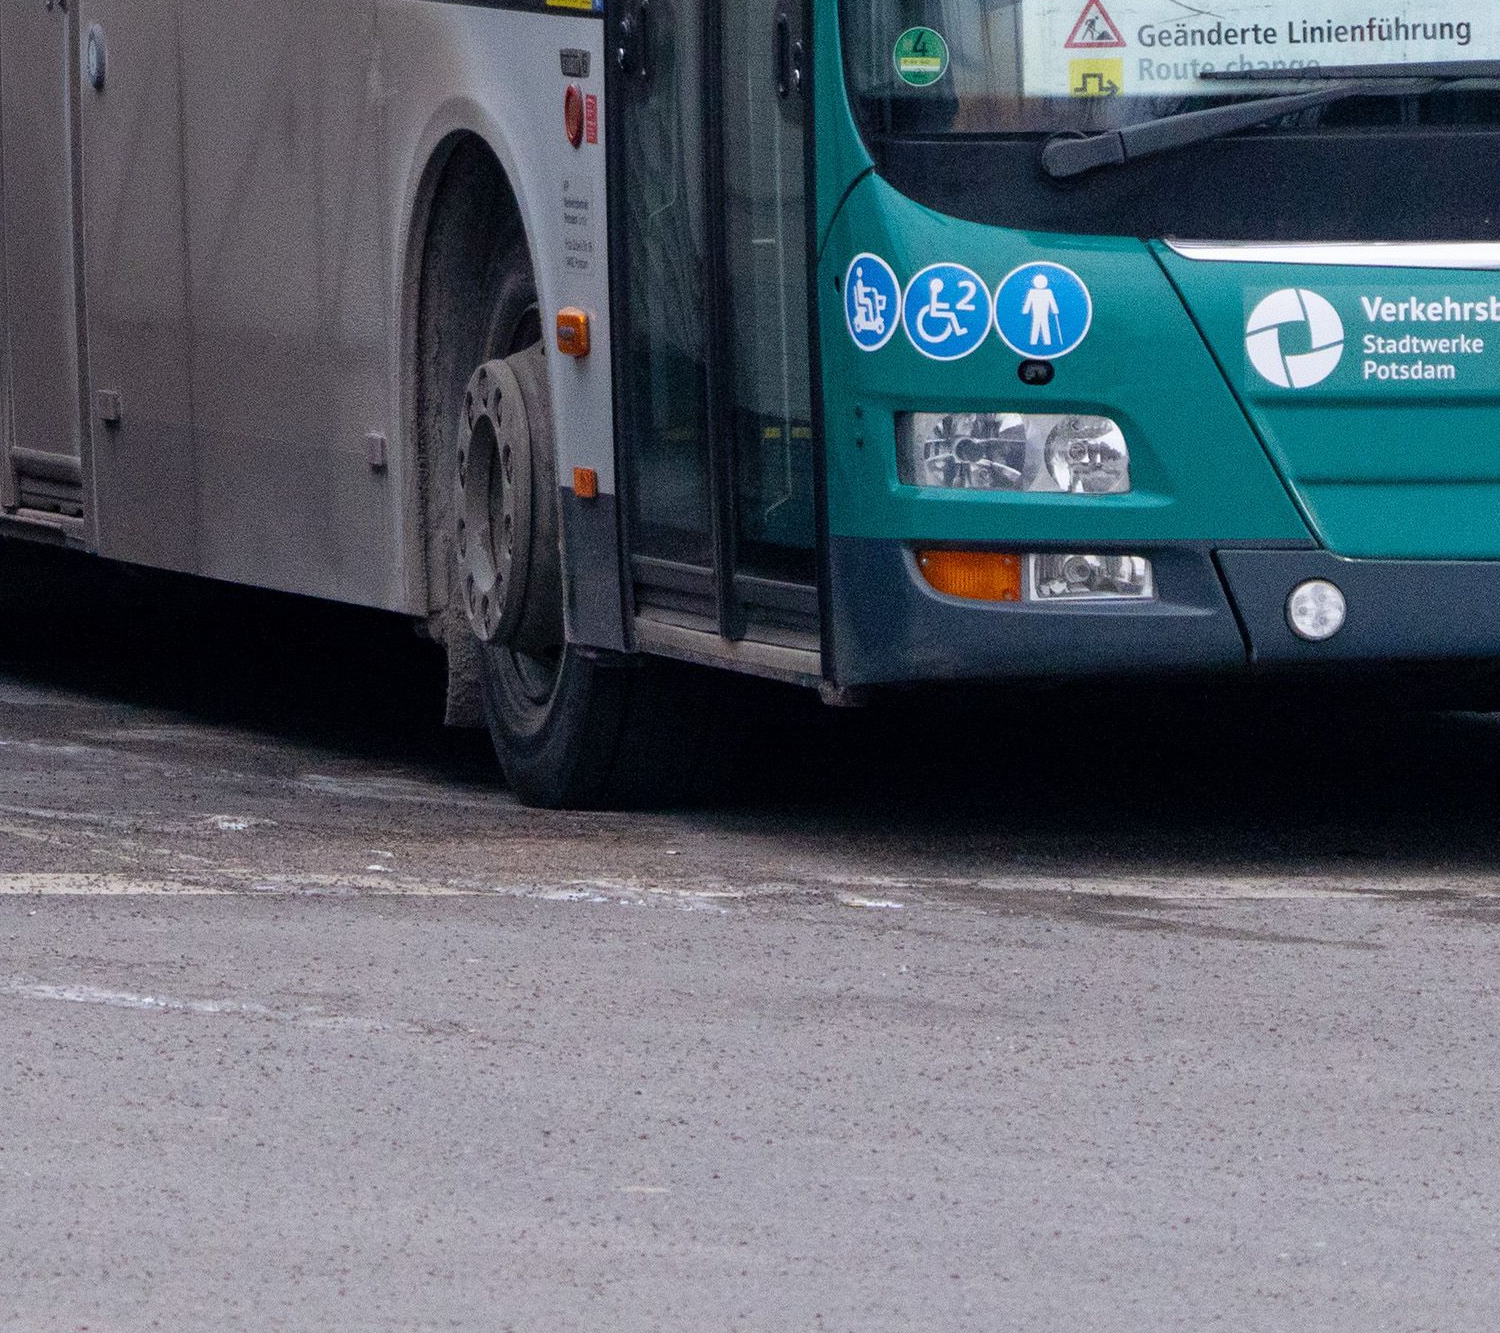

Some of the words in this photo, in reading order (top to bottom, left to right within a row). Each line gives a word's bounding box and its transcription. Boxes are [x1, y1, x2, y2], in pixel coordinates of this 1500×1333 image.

[912, 32, 928, 57] 4
[1137, 22, 1278, 48] Geänderte
[1288, 17, 1472, 46] Linienführung
[1138, 58, 1215, 81] Route
[955, 280, 977, 311] 2
[1363, 334, 1485, 354] Stadtwerke
[1363, 360, 1456, 380] Potsdam
